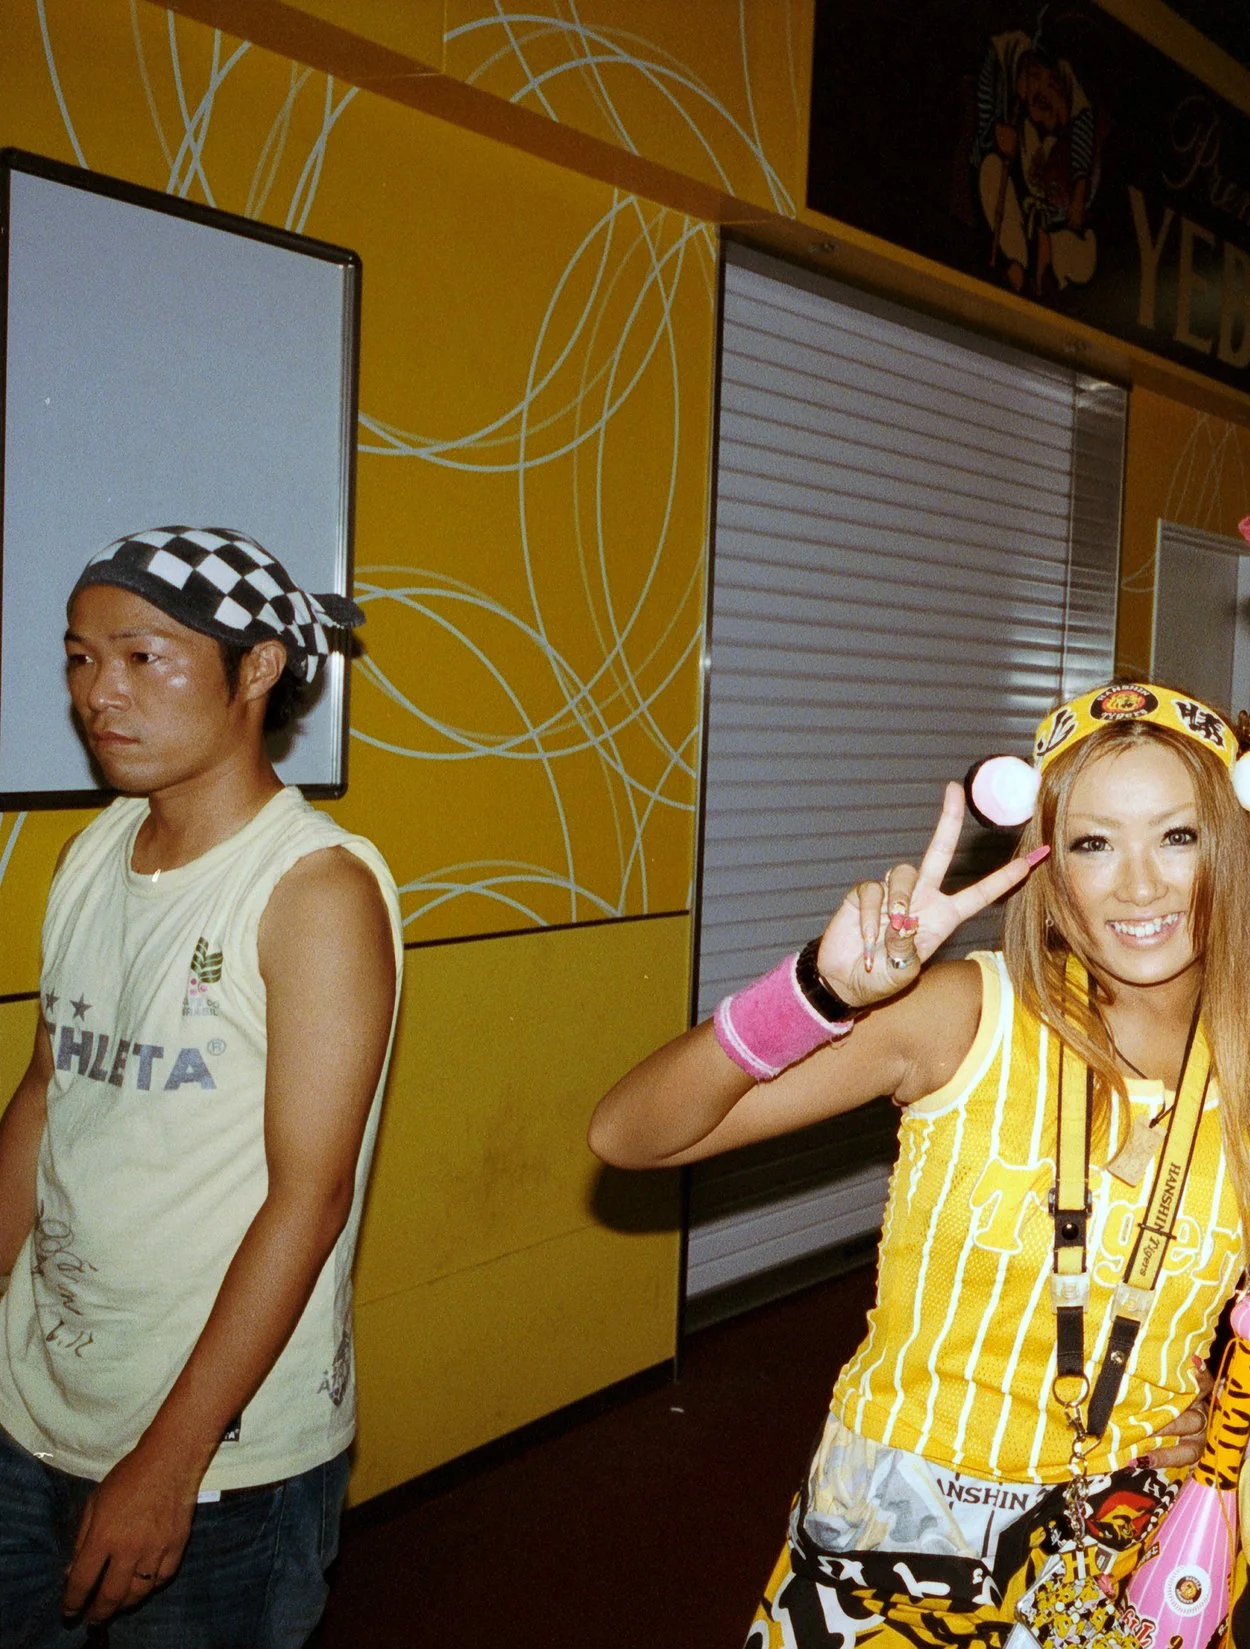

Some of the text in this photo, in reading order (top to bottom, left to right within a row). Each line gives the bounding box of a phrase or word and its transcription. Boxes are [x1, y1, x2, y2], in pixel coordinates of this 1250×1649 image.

[1096, 684, 1151, 702] HANSHIN
[1100, 708, 1149, 720] Tigers
[48, 1021, 217, 1091] HLETA
[969, 1157, 1244, 1289] Tger
[1139, 1162, 1182, 1278] HANSHIN Tigers
